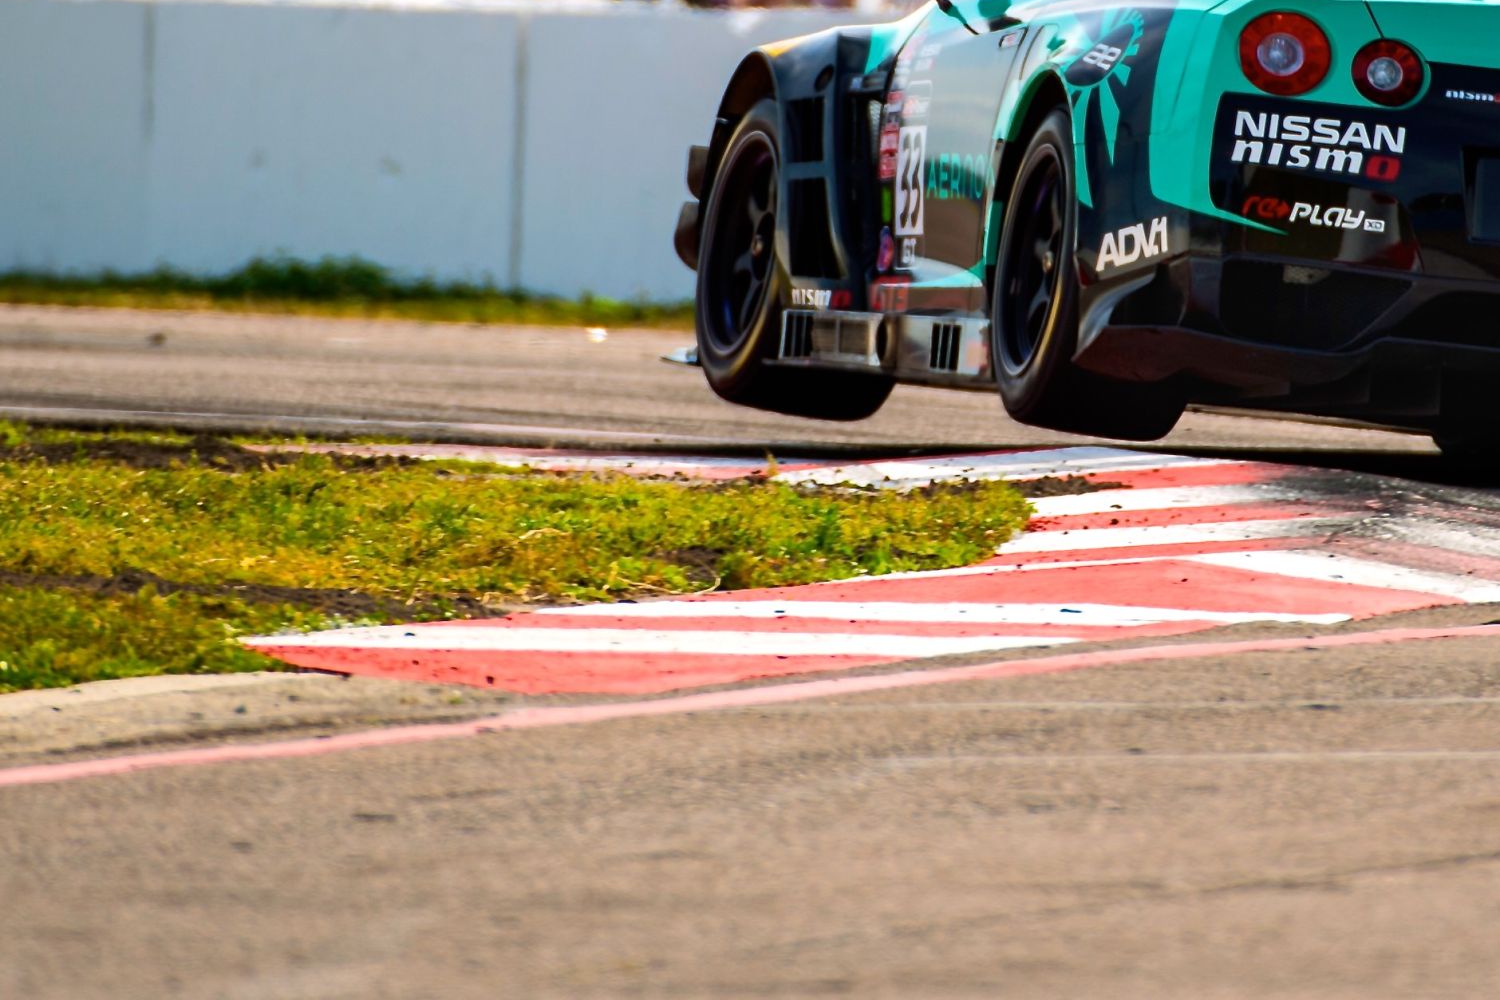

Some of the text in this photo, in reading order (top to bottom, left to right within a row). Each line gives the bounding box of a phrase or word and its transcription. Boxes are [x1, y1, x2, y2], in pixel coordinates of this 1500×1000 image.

[1233, 110, 1406, 154] NISSAN
[899, 131, 922, 230] 33
[1231, 139, 1401, 183] nismo
[902, 238, 917, 264] GT
